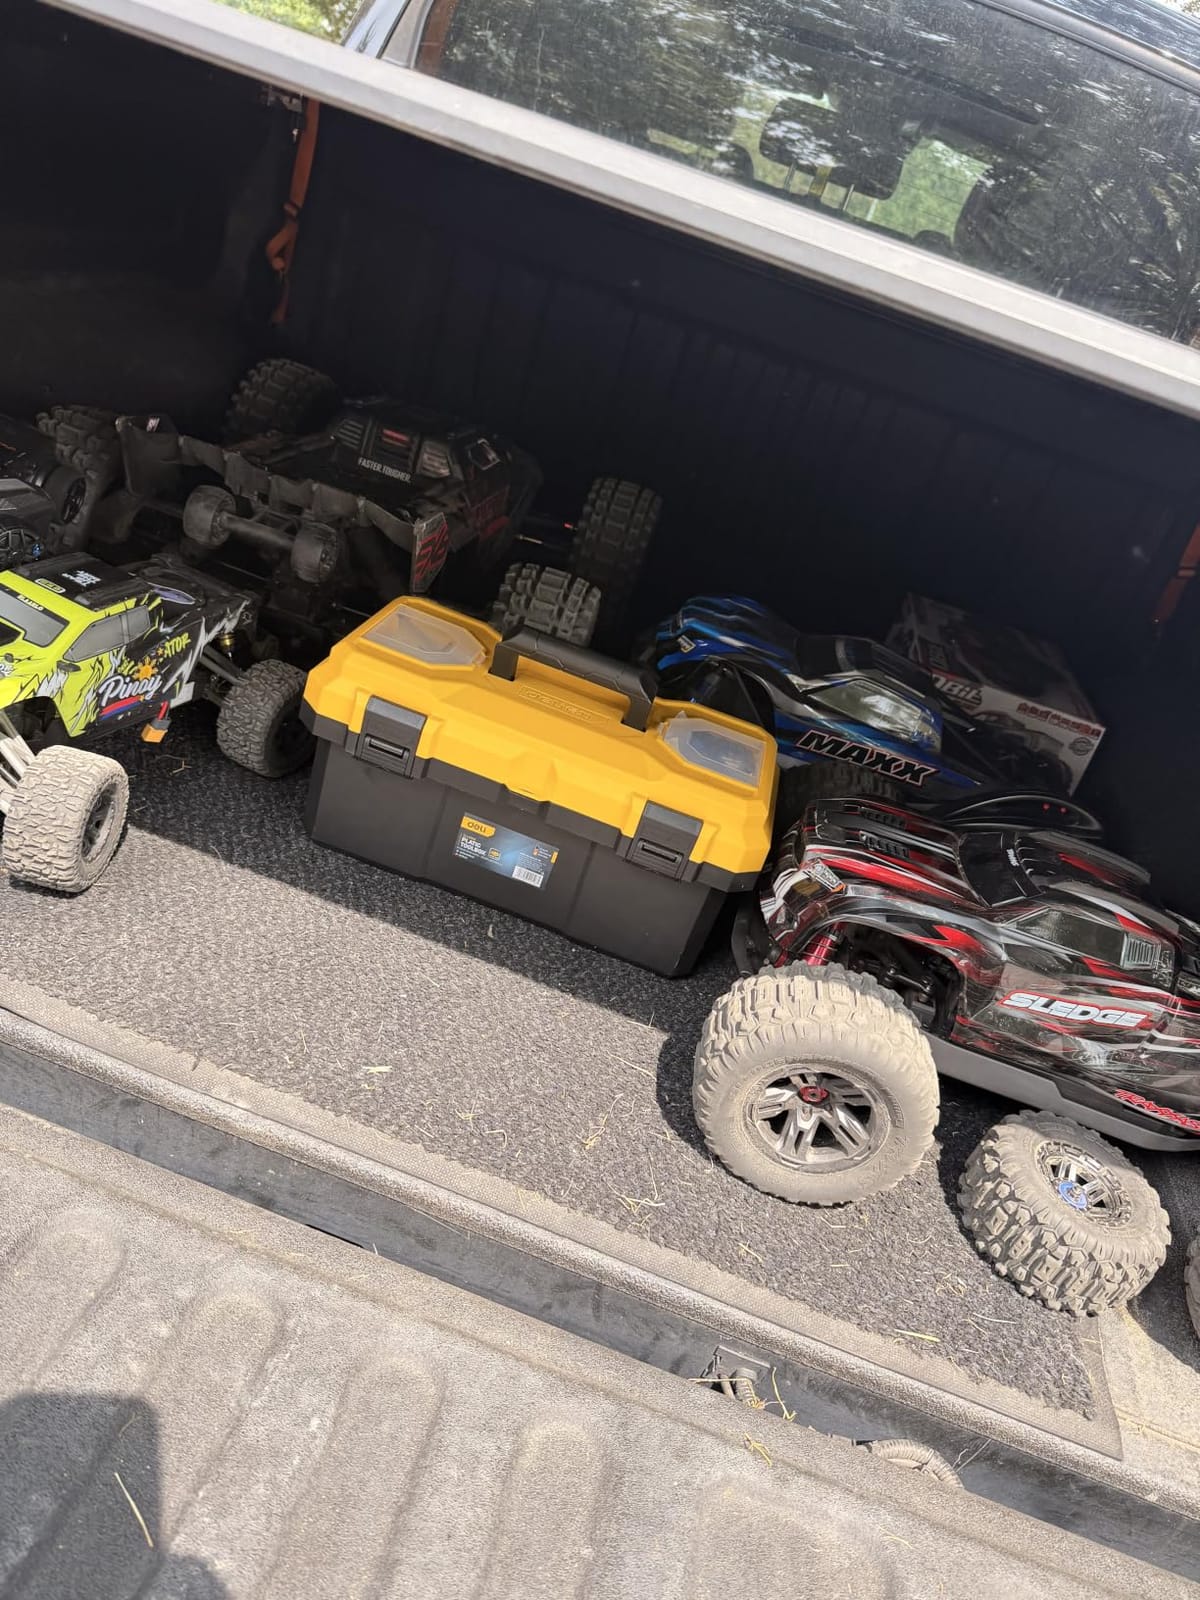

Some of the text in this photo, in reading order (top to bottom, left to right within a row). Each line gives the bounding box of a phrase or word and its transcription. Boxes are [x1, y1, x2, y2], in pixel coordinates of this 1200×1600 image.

[98, 674, 163, 707] Pinoy
[797, 731, 935, 785] MAXX
[1002, 991, 1148, 1028] SLEDGE
